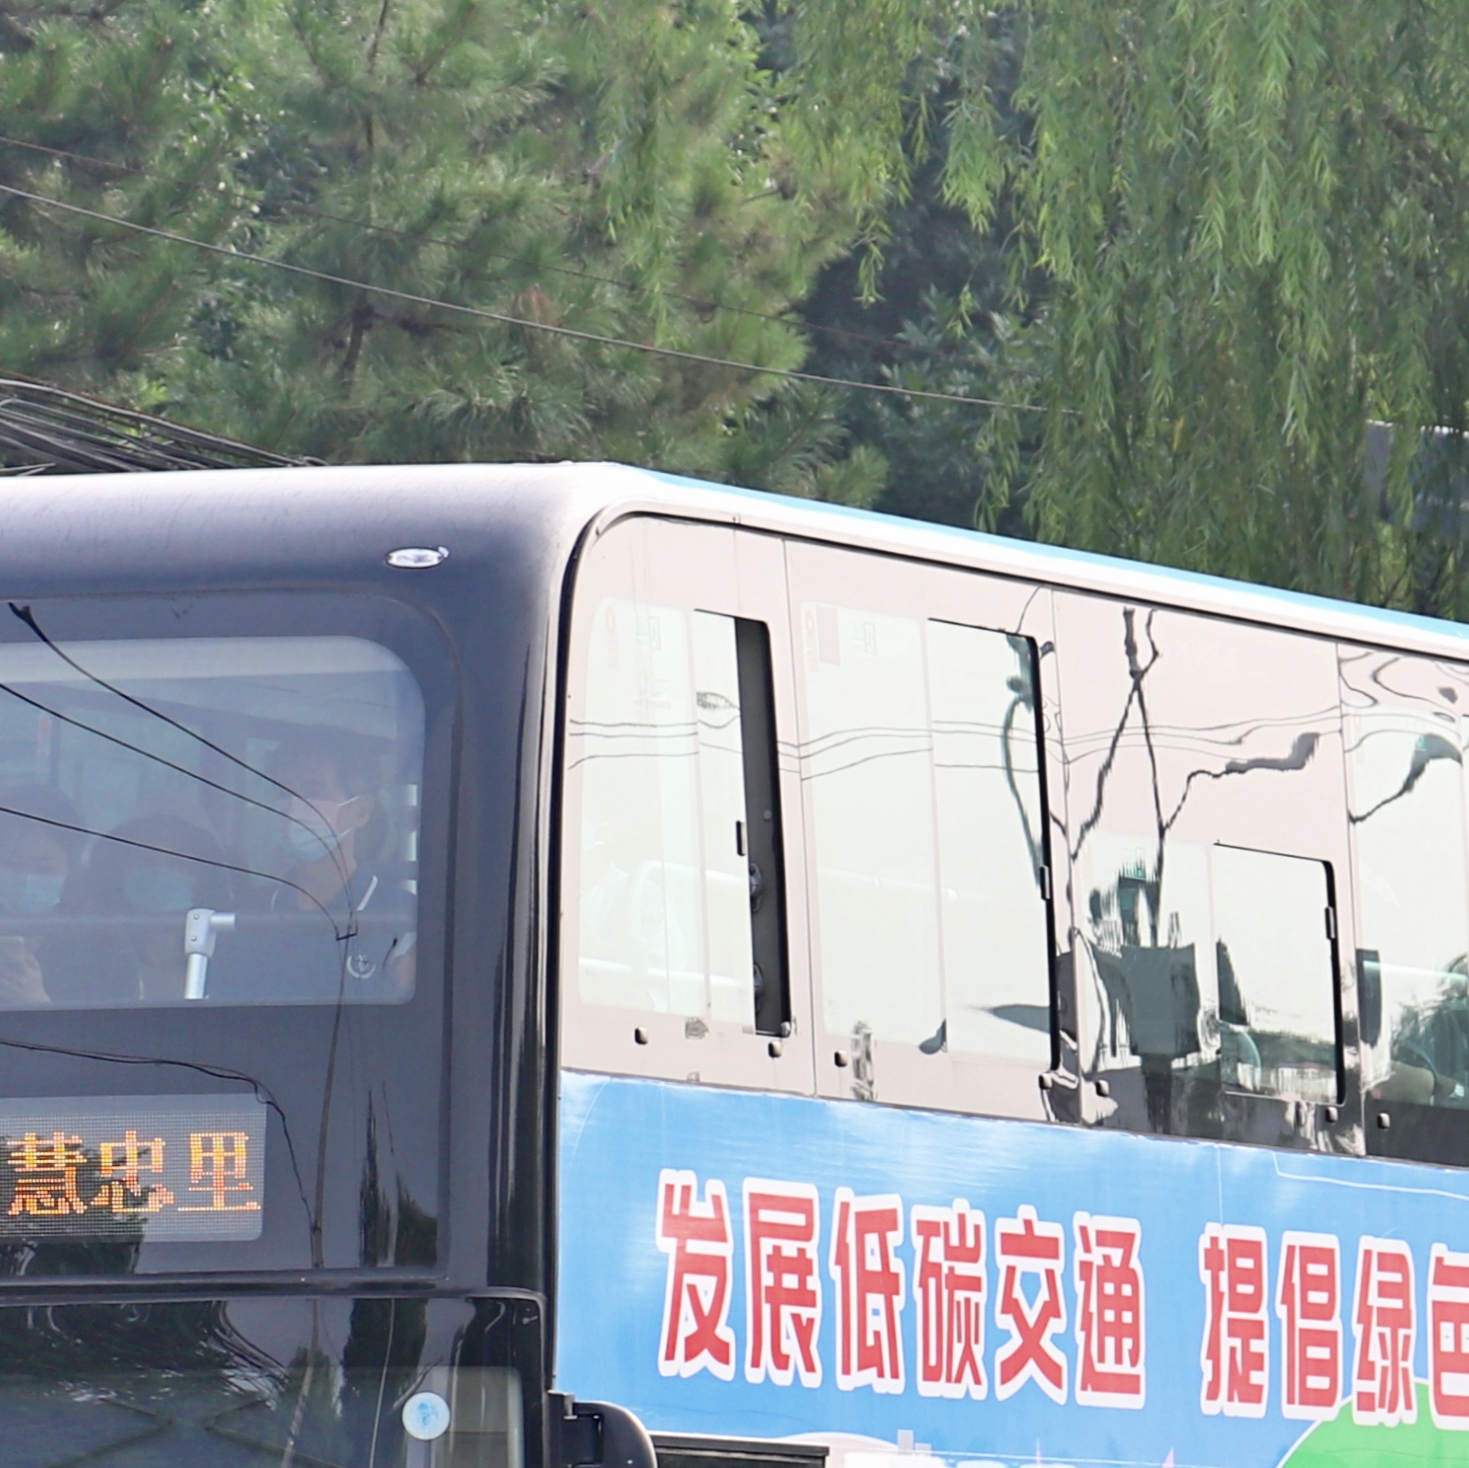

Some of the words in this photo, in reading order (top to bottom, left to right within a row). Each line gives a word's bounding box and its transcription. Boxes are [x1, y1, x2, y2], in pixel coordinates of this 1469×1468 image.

[7, 1130, 262, 1216] 慧忠里
[657, 1169, 1146, 1407] 发展低碳交通
